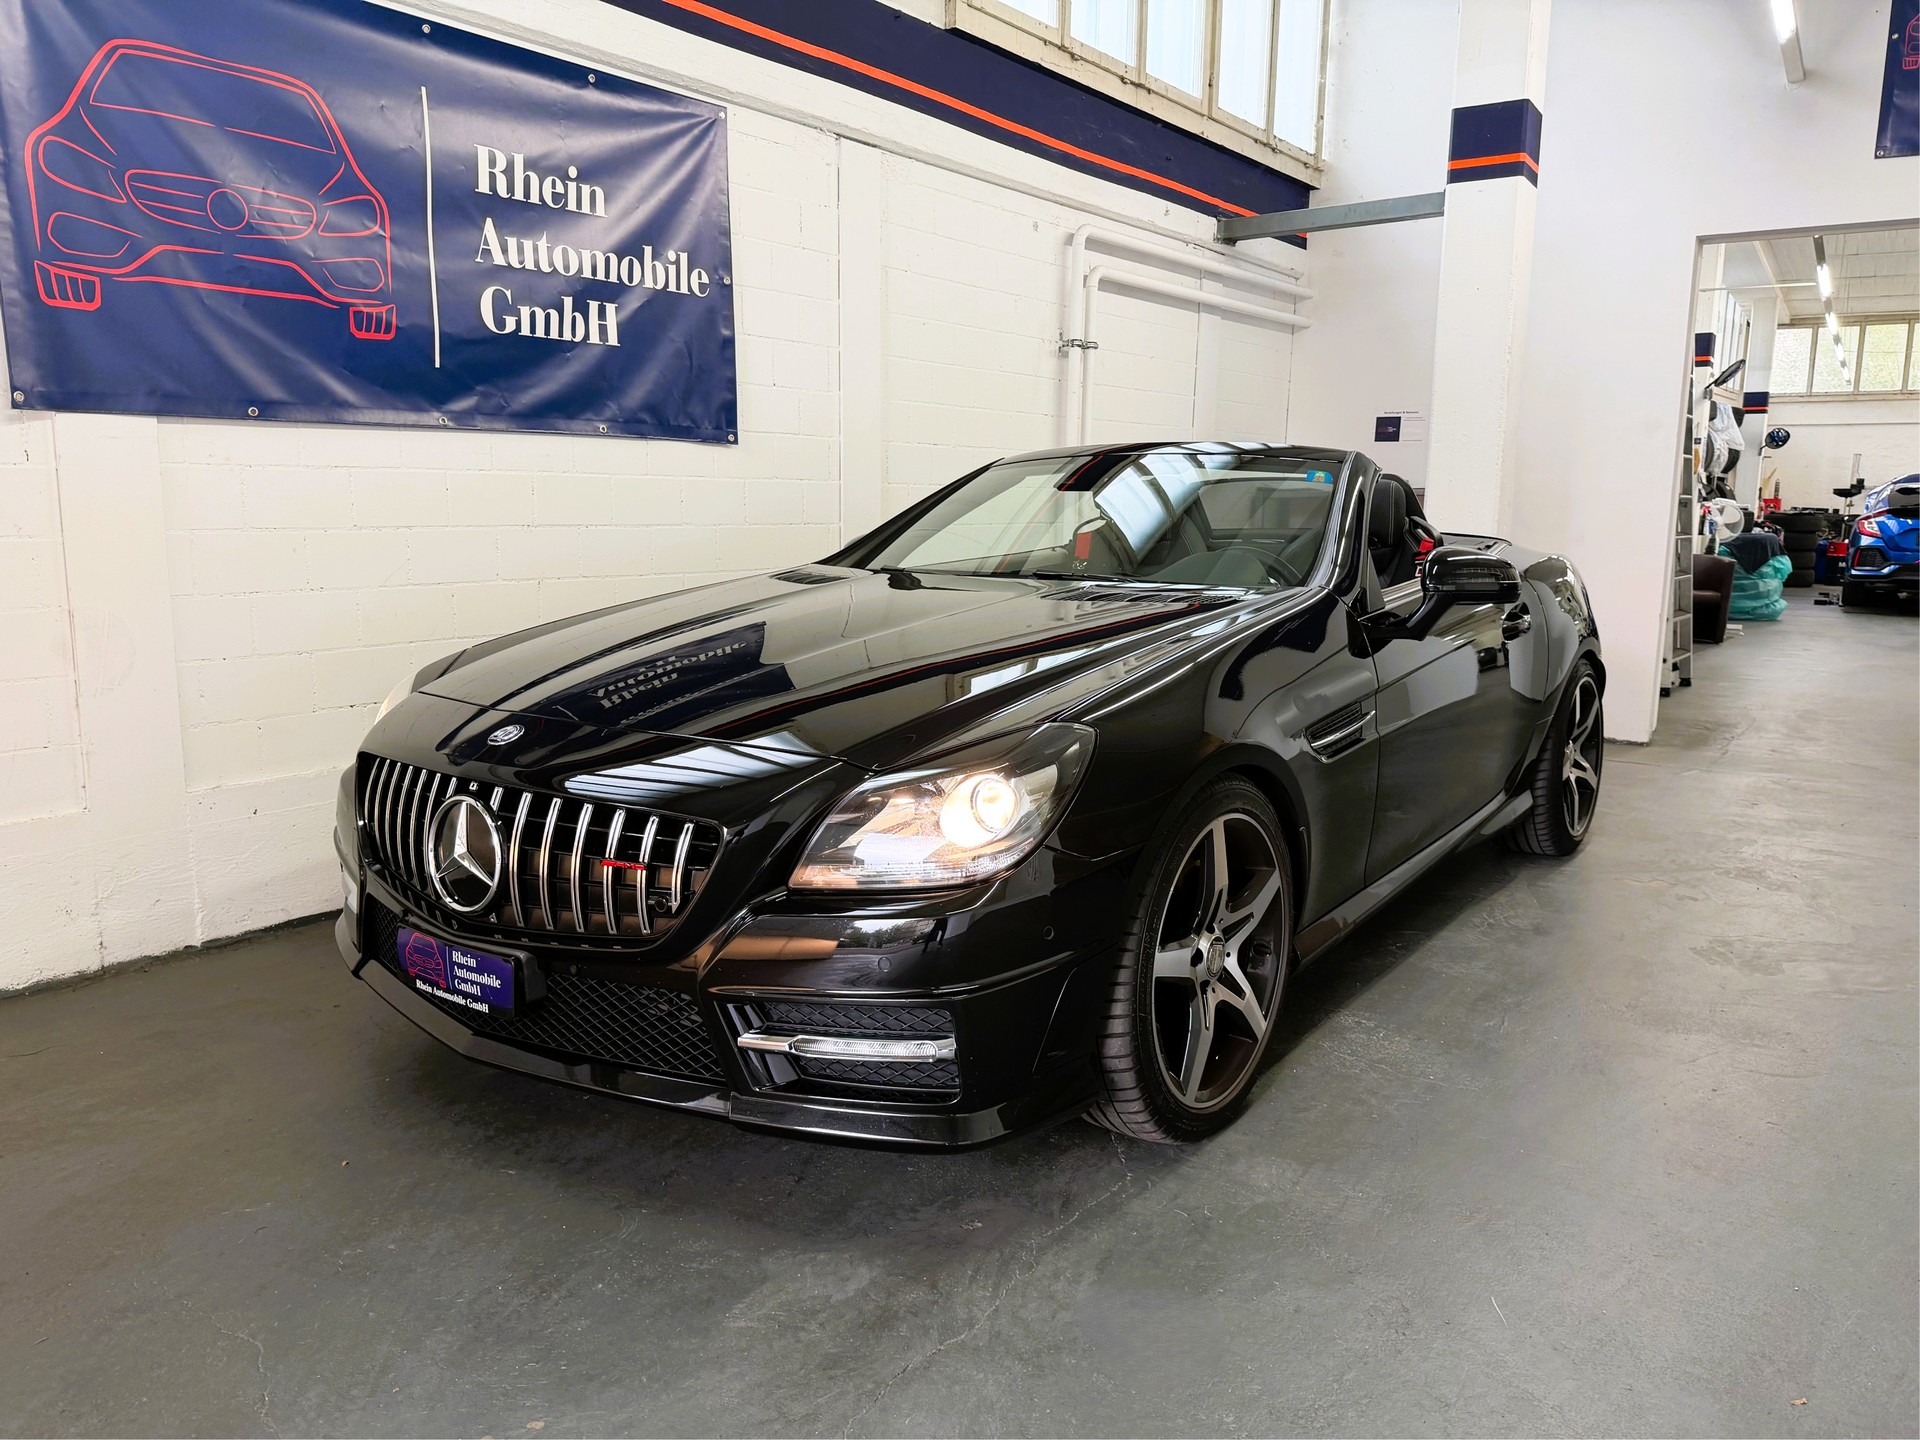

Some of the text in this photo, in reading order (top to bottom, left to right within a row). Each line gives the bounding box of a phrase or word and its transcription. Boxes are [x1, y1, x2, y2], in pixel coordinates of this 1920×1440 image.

[474, 144, 607, 218] Rhein
[475, 217, 710, 298] Automobile
[480, 286, 620, 346] GmbH
[452, 951, 476, 967] Rhein
[453, 965, 501, 988] Automobile
[454, 979, 481, 996] GmbH
[416, 979, 489, 1013] Rhein Automobile GmbH
